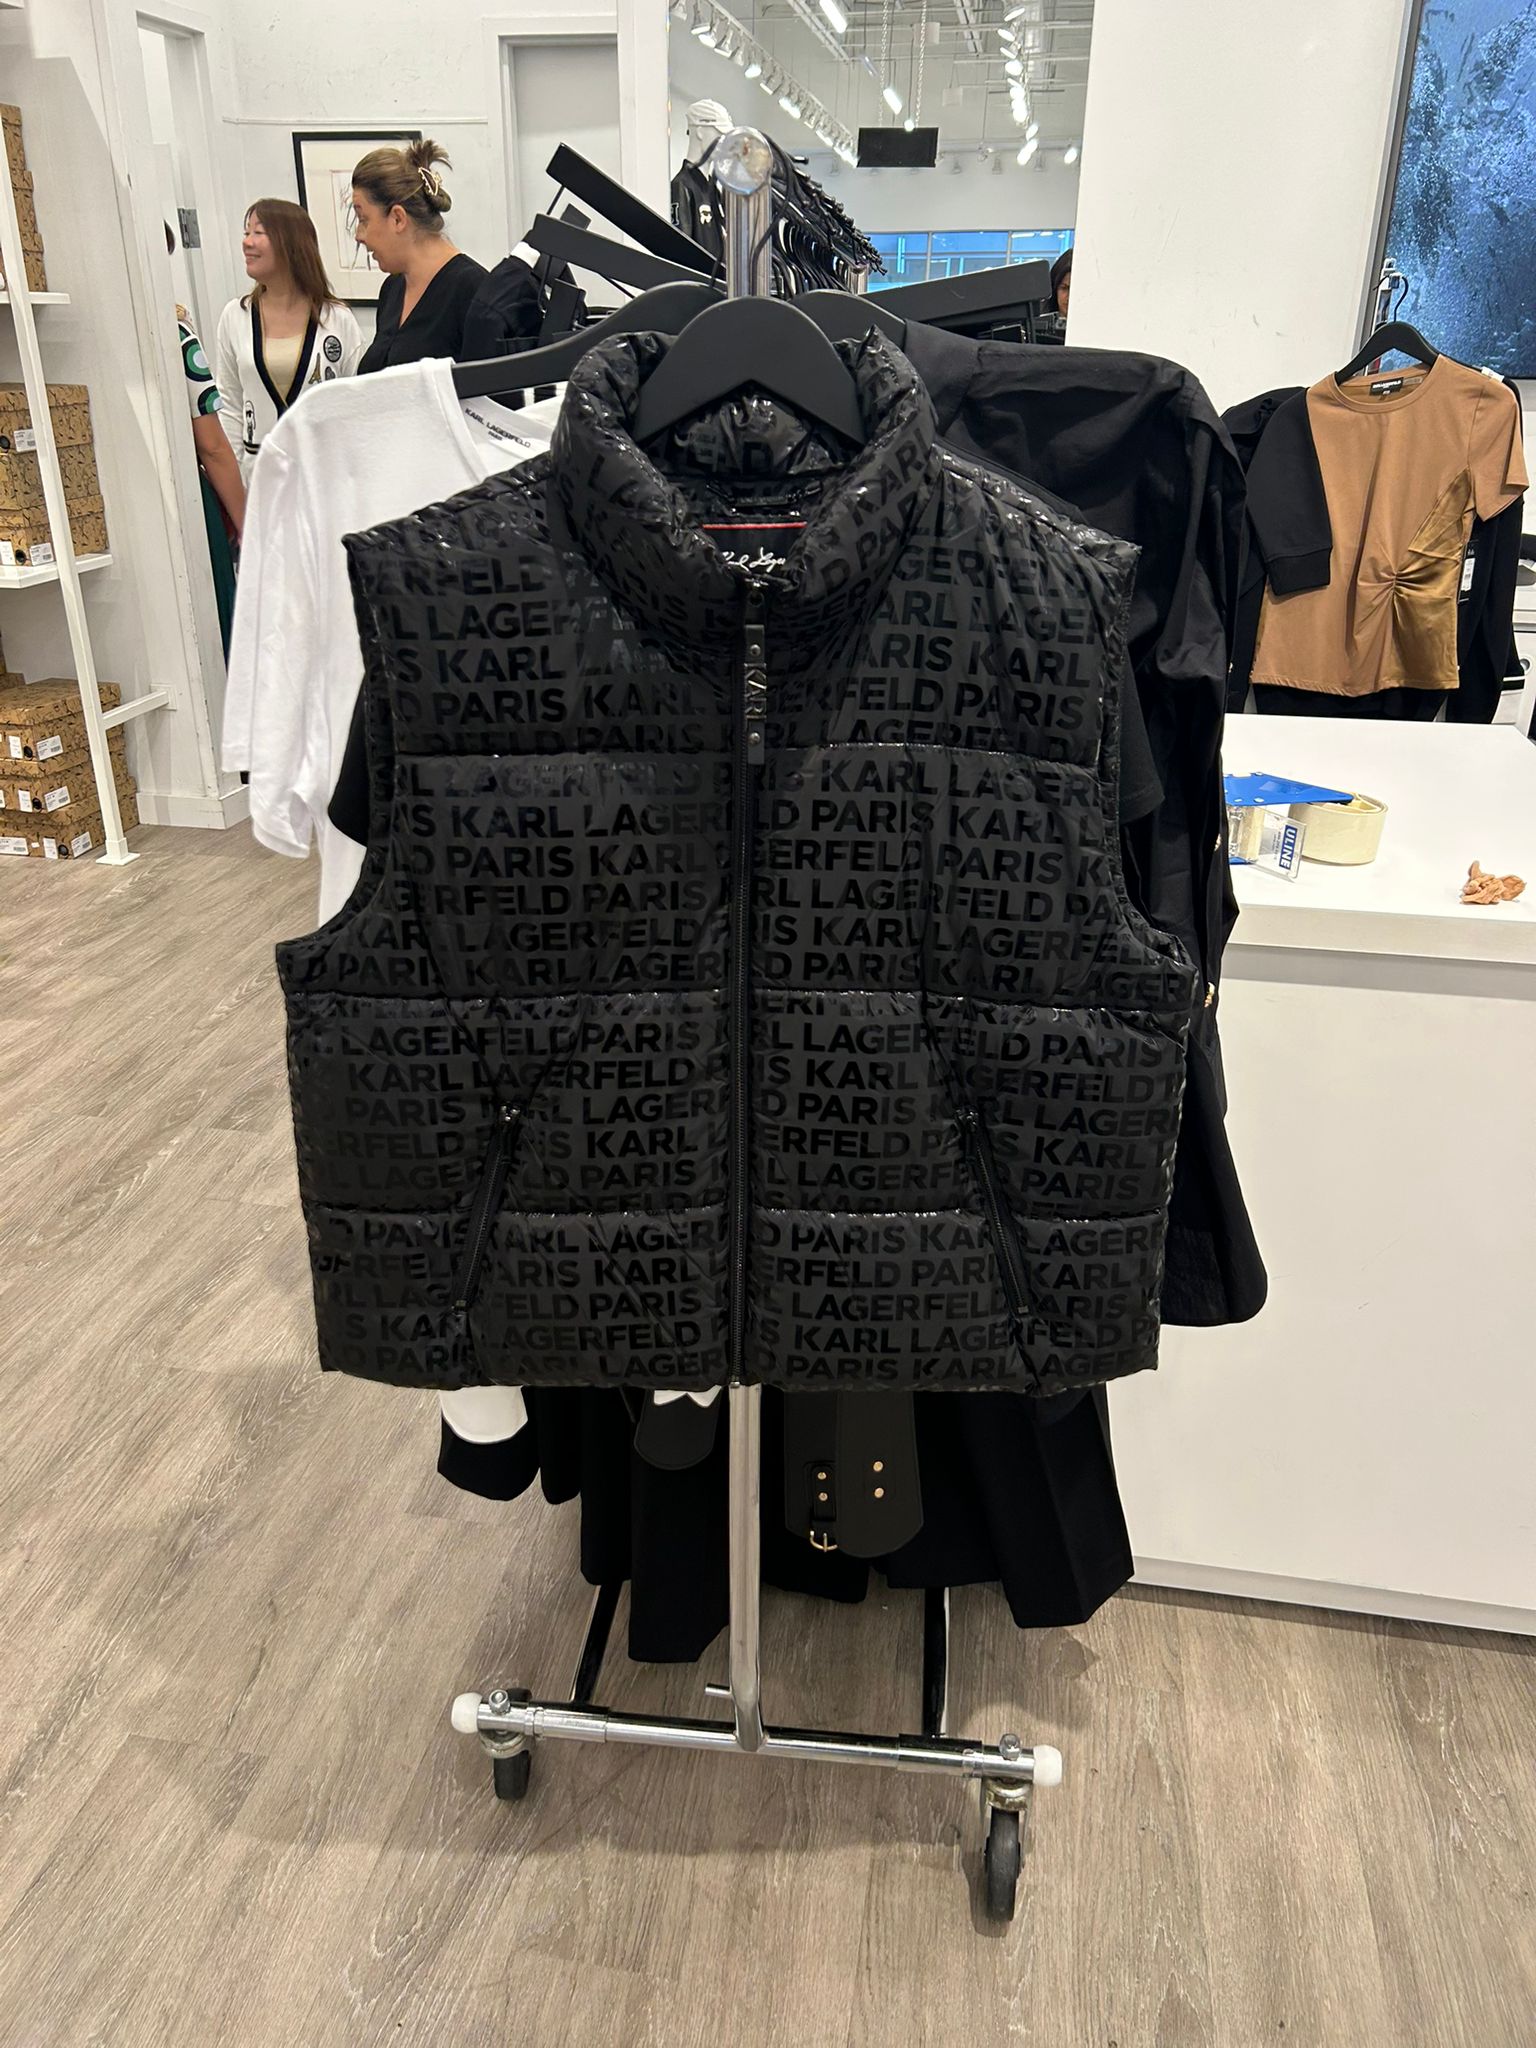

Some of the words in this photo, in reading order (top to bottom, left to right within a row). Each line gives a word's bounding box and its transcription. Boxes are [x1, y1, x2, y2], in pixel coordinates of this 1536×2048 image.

[465, 408, 484, 425] KARL
[486, 421, 531, 448] LAGERFELD
[437, 645, 566, 684] KARL
[967, 640, 1091, 688] KARL
[433, 688, 567, 725] PARIS
[583, 683, 705, 718] KARL
[954, 683, 1084, 731] PARIS
[576, 723, 704, 755] PARIS
[822, 759, 938, 796] KARL
[451, 805, 574, 838] KARL
[811, 800, 934, 833] PARIS
[951, 805, 1065, 846] KARL
[446, 846, 574, 878] PARIS
[590, 843, 707, 878] KARL
[937, 843, 1063, 885] PARIS
[1280, 827, 1297, 869] ULINE
[583, 880, 707, 913] PARIS
[811, 878, 1052, 923] LAGERFELD
[456, 918, 700, 952] LAGERFELD
[813, 917, 923, 948] KARL
[465, 955, 581, 988] KARL
[803, 952, 920, 983] PARIS
[930, 957, 1042, 994] KARL
[342, 1024, 578, 1057] LAGERFELD
[582, 1021, 701, 1053] PARIS
[803, 1022, 1031, 1061] LAGERFELD
[1041, 1033, 1164, 1068] PARIS
[348, 1063, 463, 1092] KARL
[473, 1057, 696, 1090] LAGERFELD
[806, 1059, 918, 1090] KARL
[928, 1060, 1154, 1103] LAGERFELD
[345, 1095, 466, 1127] PARIS
[798, 1092, 916, 1125] PARIS
[587, 1126, 698, 1158] KARL
[1034, 1136, 1147, 1170] KARL
[581, 1159, 696, 1190] PARIS
[1021, 1167, 1141, 1200] PARIS
[792, 1223, 906, 1254] PARIS
[595, 1255, 700, 1287] KARL
[589, 1286, 702, 1320] PARIS
[795, 1325, 901, 1353] KARL
[786, 1355, 899, 1380] PARIS
[912, 1355, 1017, 1380] KARL
